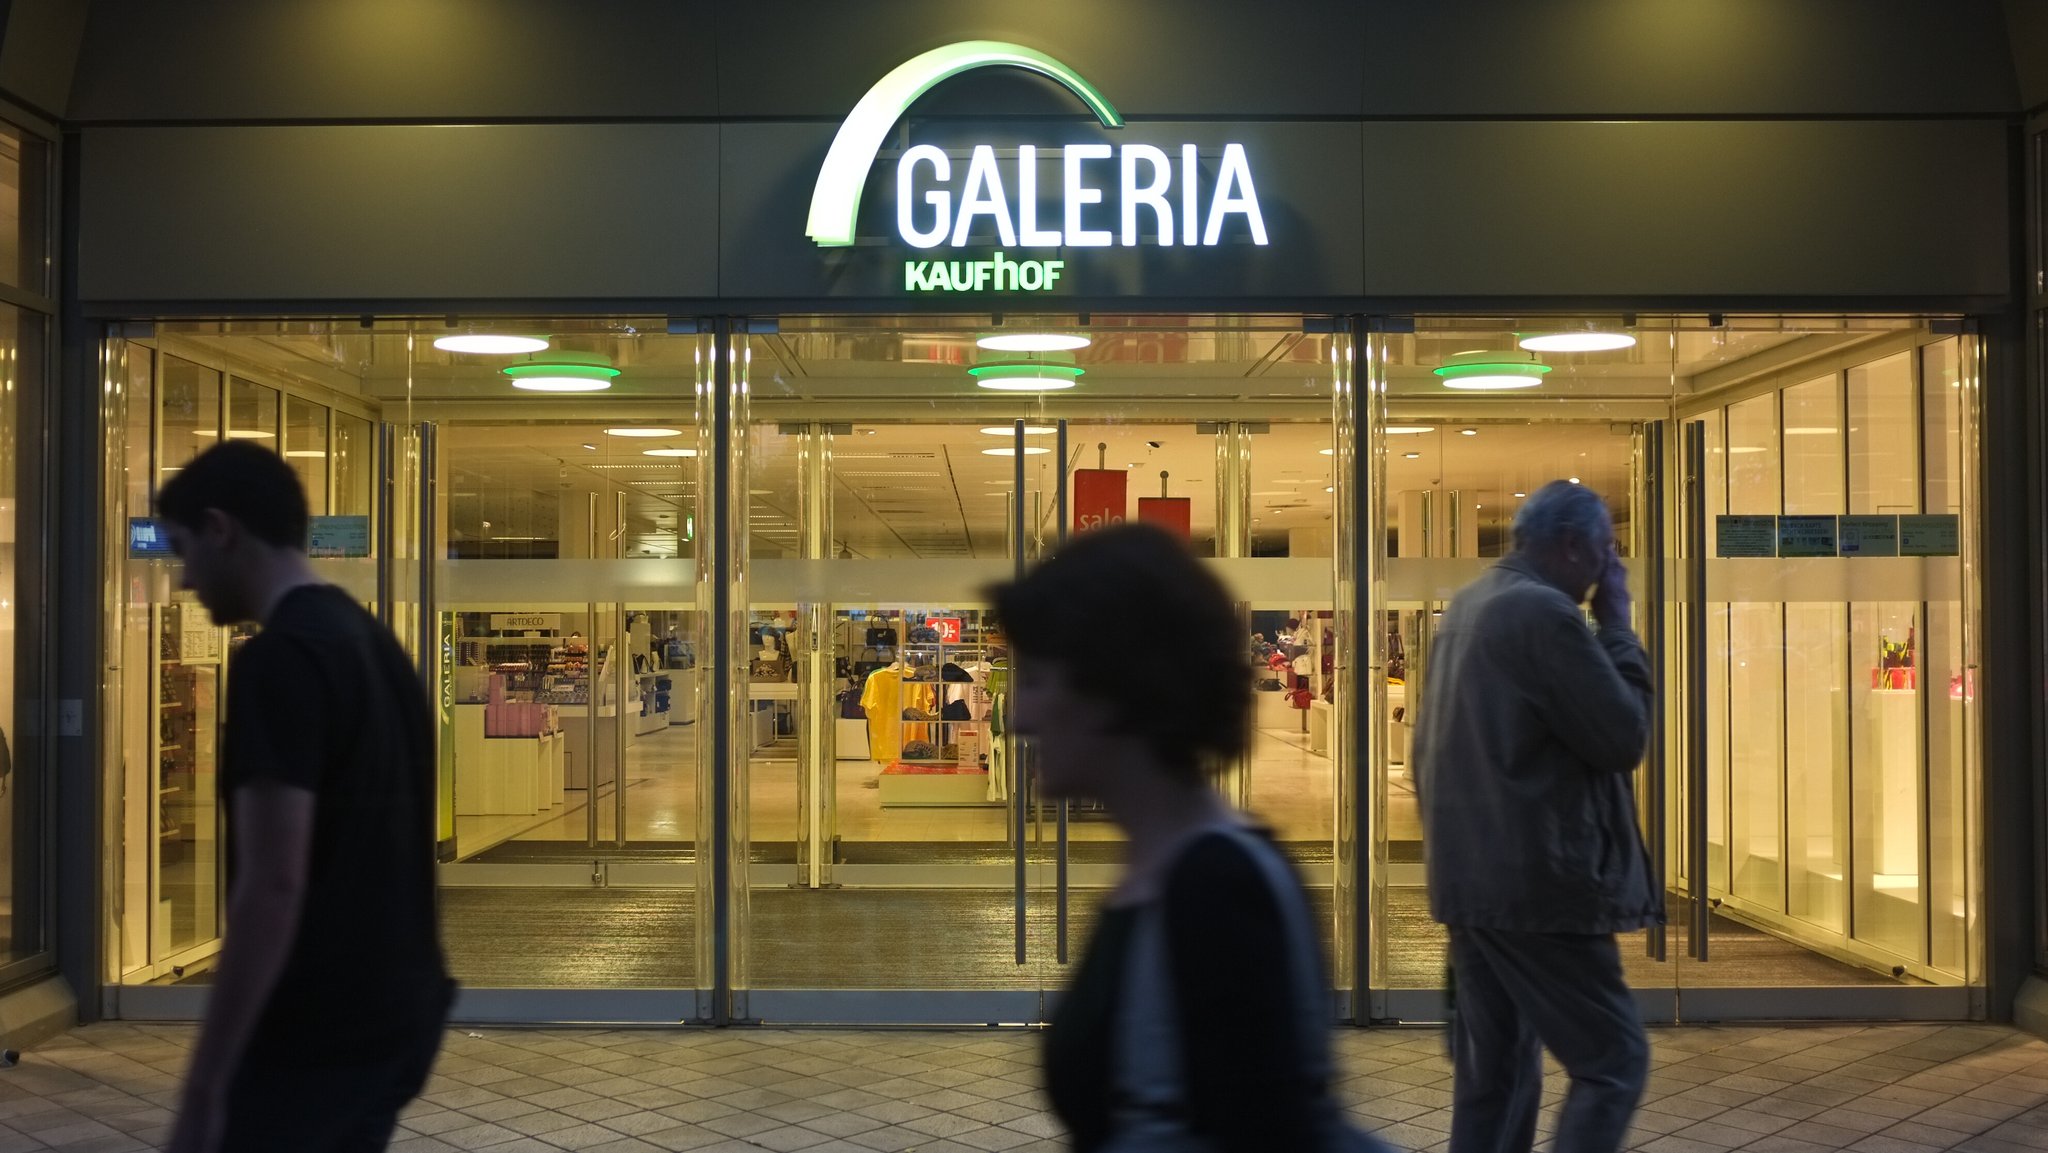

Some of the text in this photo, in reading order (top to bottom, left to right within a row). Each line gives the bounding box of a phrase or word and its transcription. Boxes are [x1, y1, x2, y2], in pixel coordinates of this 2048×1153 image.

[897, 143, 1269, 249] GALERIA
[506, 617, 545, 626] ARTDECO
[443, 634, 451, 708] GALERIA
